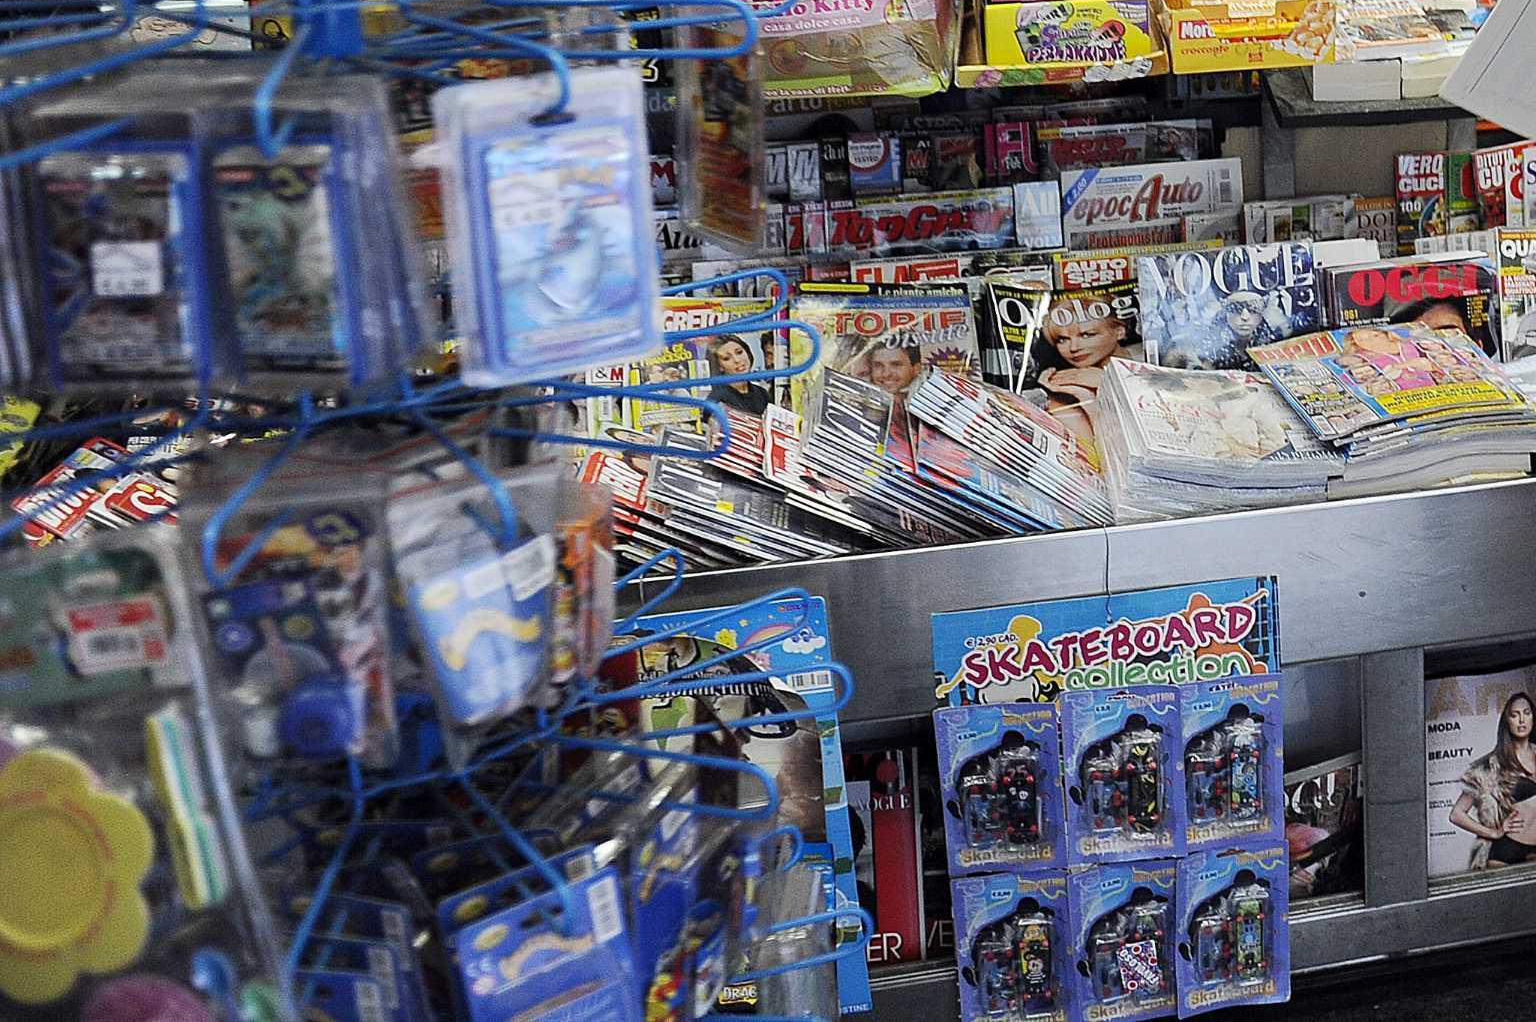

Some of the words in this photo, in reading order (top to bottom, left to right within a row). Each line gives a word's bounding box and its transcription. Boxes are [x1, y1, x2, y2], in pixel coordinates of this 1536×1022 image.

[764, 21, 794, 33] casa
[795, 17, 830, 31] dolce
[831, 15, 861, 28] casa
[1397, 153, 1444, 175] VERO
[1063, 258, 1128, 272] AUTO
[1142, 241, 1314, 298] VOGUE
[878, 286, 890, 296] Le
[892, 287, 927, 299] piante
[928, 285, 964, 297] amiche
[1347, 263, 1478, 307] OGGI
[1000, 289, 1142, 327] Oolog
[963, 604, 1255, 686] SKATEBOARD
[1064, 652, 1251, 691] collection
[1427, 721, 1461, 734] MODA
[1428, 747, 1474, 761] BEAUTY
[857, 794, 910, 813] VOGUE
[959, 846, 1054, 865] Skatoard
[1188, 978, 1276, 1007] Skatoard
